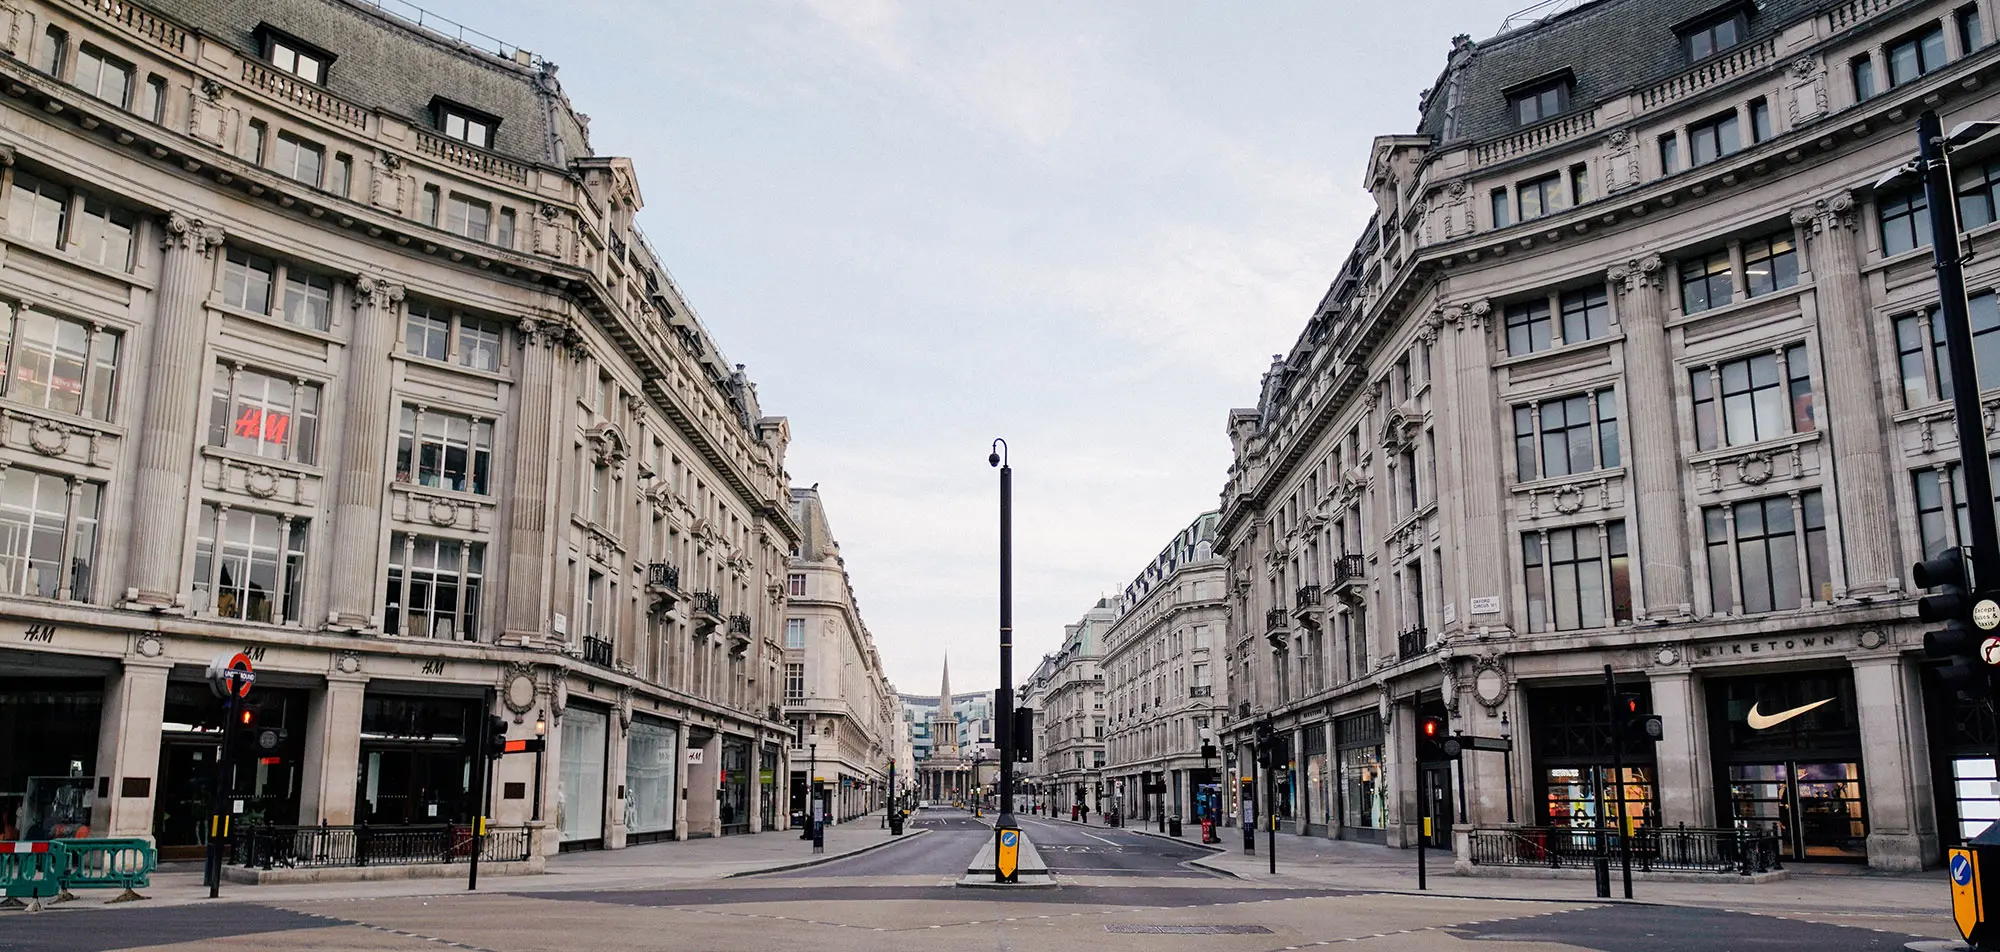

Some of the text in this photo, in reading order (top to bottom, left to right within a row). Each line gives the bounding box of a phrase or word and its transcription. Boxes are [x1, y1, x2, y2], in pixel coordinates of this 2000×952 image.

[235, 407, 289, 445] H&M
[23, 624, 56, 643] H&M
[1702, 636, 1834, 656] NIKETOWN
[421, 660, 445, 676] H&M
